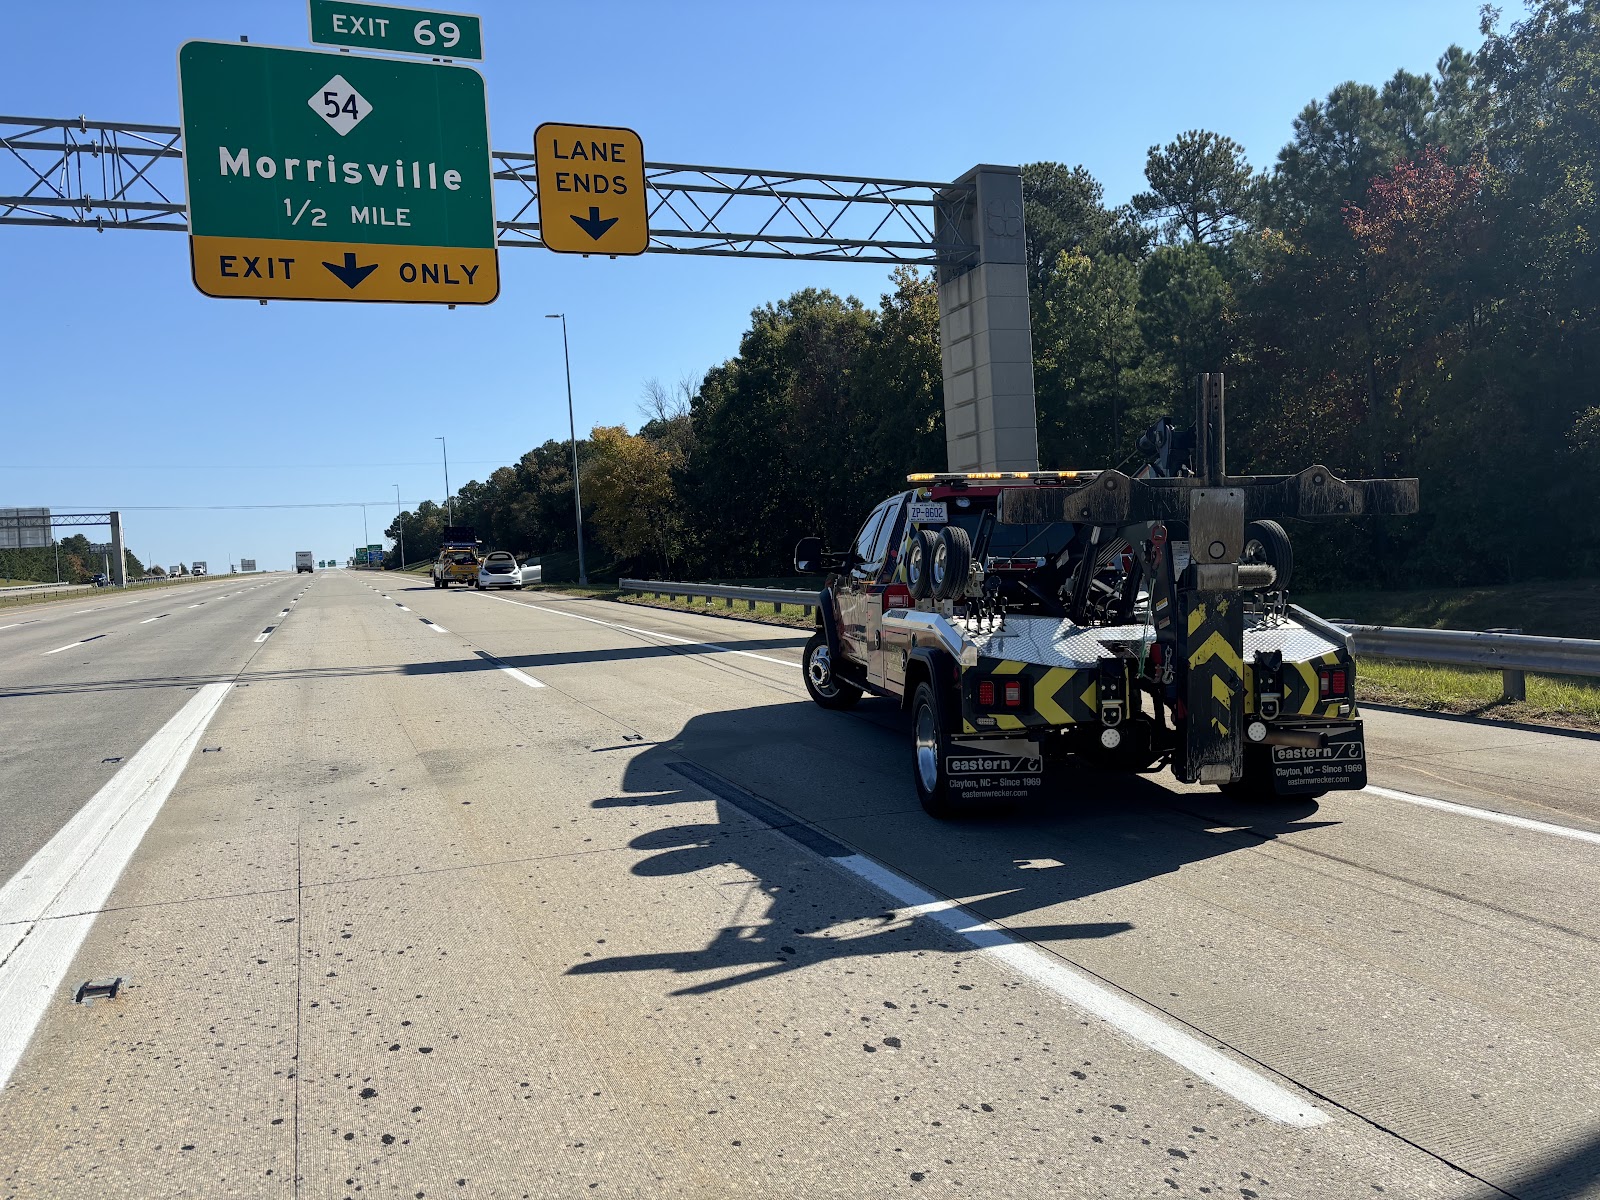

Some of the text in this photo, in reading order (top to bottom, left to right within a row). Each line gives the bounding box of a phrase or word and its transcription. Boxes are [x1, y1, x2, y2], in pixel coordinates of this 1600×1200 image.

[332, 14, 461, 48] EXIT 69
[323, 91, 359, 120] 54
[553, 139, 625, 163] LANE
[218, 147, 463, 191] Morrisville
[555, 173, 628, 195] ENDS
[283, 198, 411, 228] 1/2 MILE
[219, 256, 480, 285] EXIT ONLY
[911, 507, 944, 518] ZP-8602
[1277, 747, 1332, 759] eastern
[952, 758, 1010, 770] eastern
[1275, 767, 1302, 777] Clayton,
[1303, 765, 1314, 775] NC
[1321, 764, 1342, 774] Since
[1343, 763, 1363, 773] 1969
[949, 779, 979, 789] Clayton,
[980, 778, 991, 787] NC
[999, 778, 1020, 787] Since
[1022, 777, 1041, 786] 1969
[1287, 776, 1350, 785] easternwrecker.com
[961, 789, 1028, 798] easternwrecker.com
